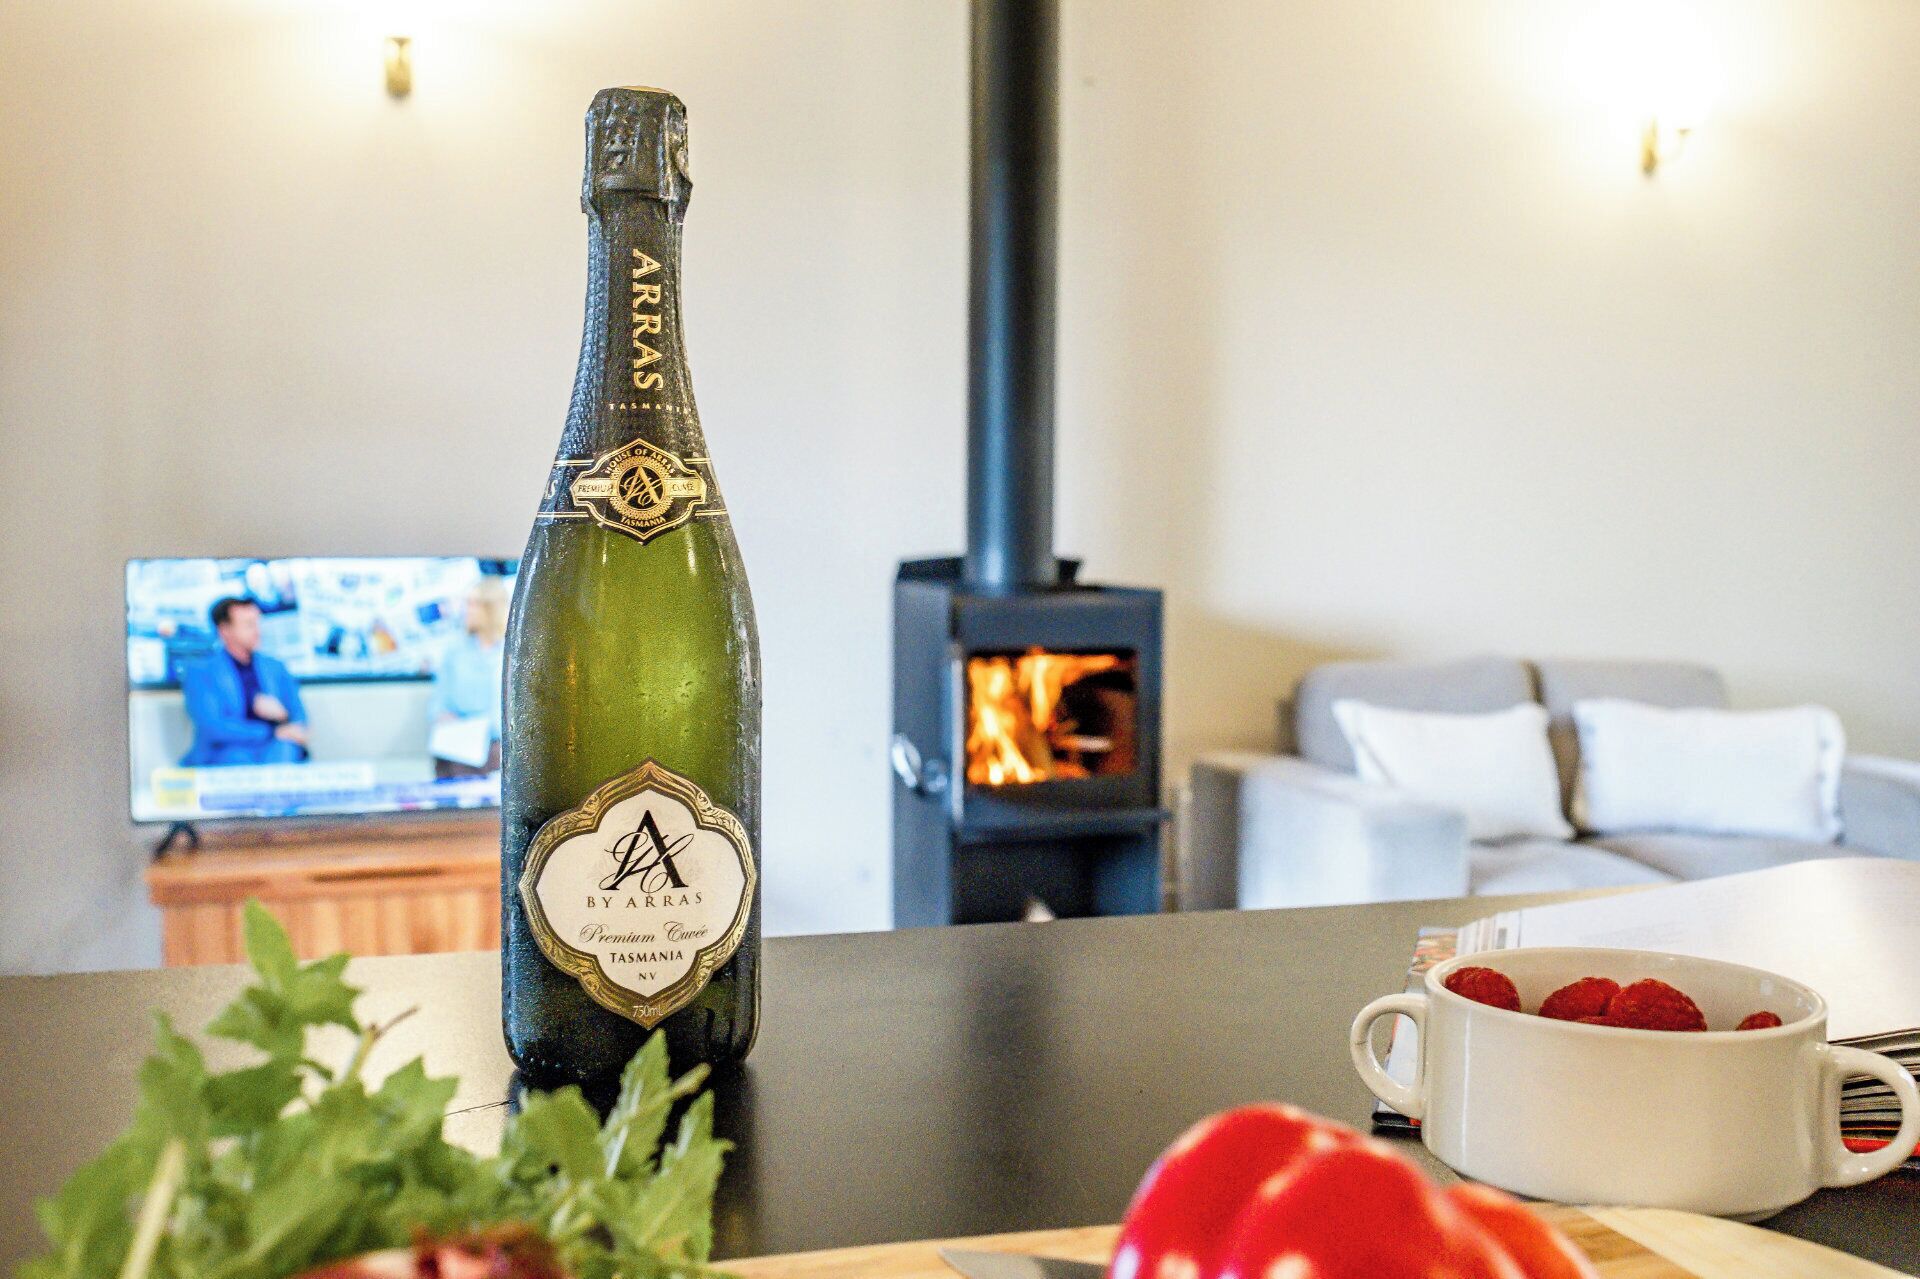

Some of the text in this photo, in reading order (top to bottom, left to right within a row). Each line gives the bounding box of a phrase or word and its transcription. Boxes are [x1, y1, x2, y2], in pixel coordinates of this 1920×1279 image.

[632, 248, 664, 391] ARRAS
[604, 448, 676, 474] HOUSE OF ARRAS
[620, 516, 667, 527] TASMANIA
[586, 891, 702, 909] BY ARRAS
[578, 920, 709, 944] Premium Cuvée
[609, 950, 684, 964] TASMANIA
[638, 972, 657, 981] NV
